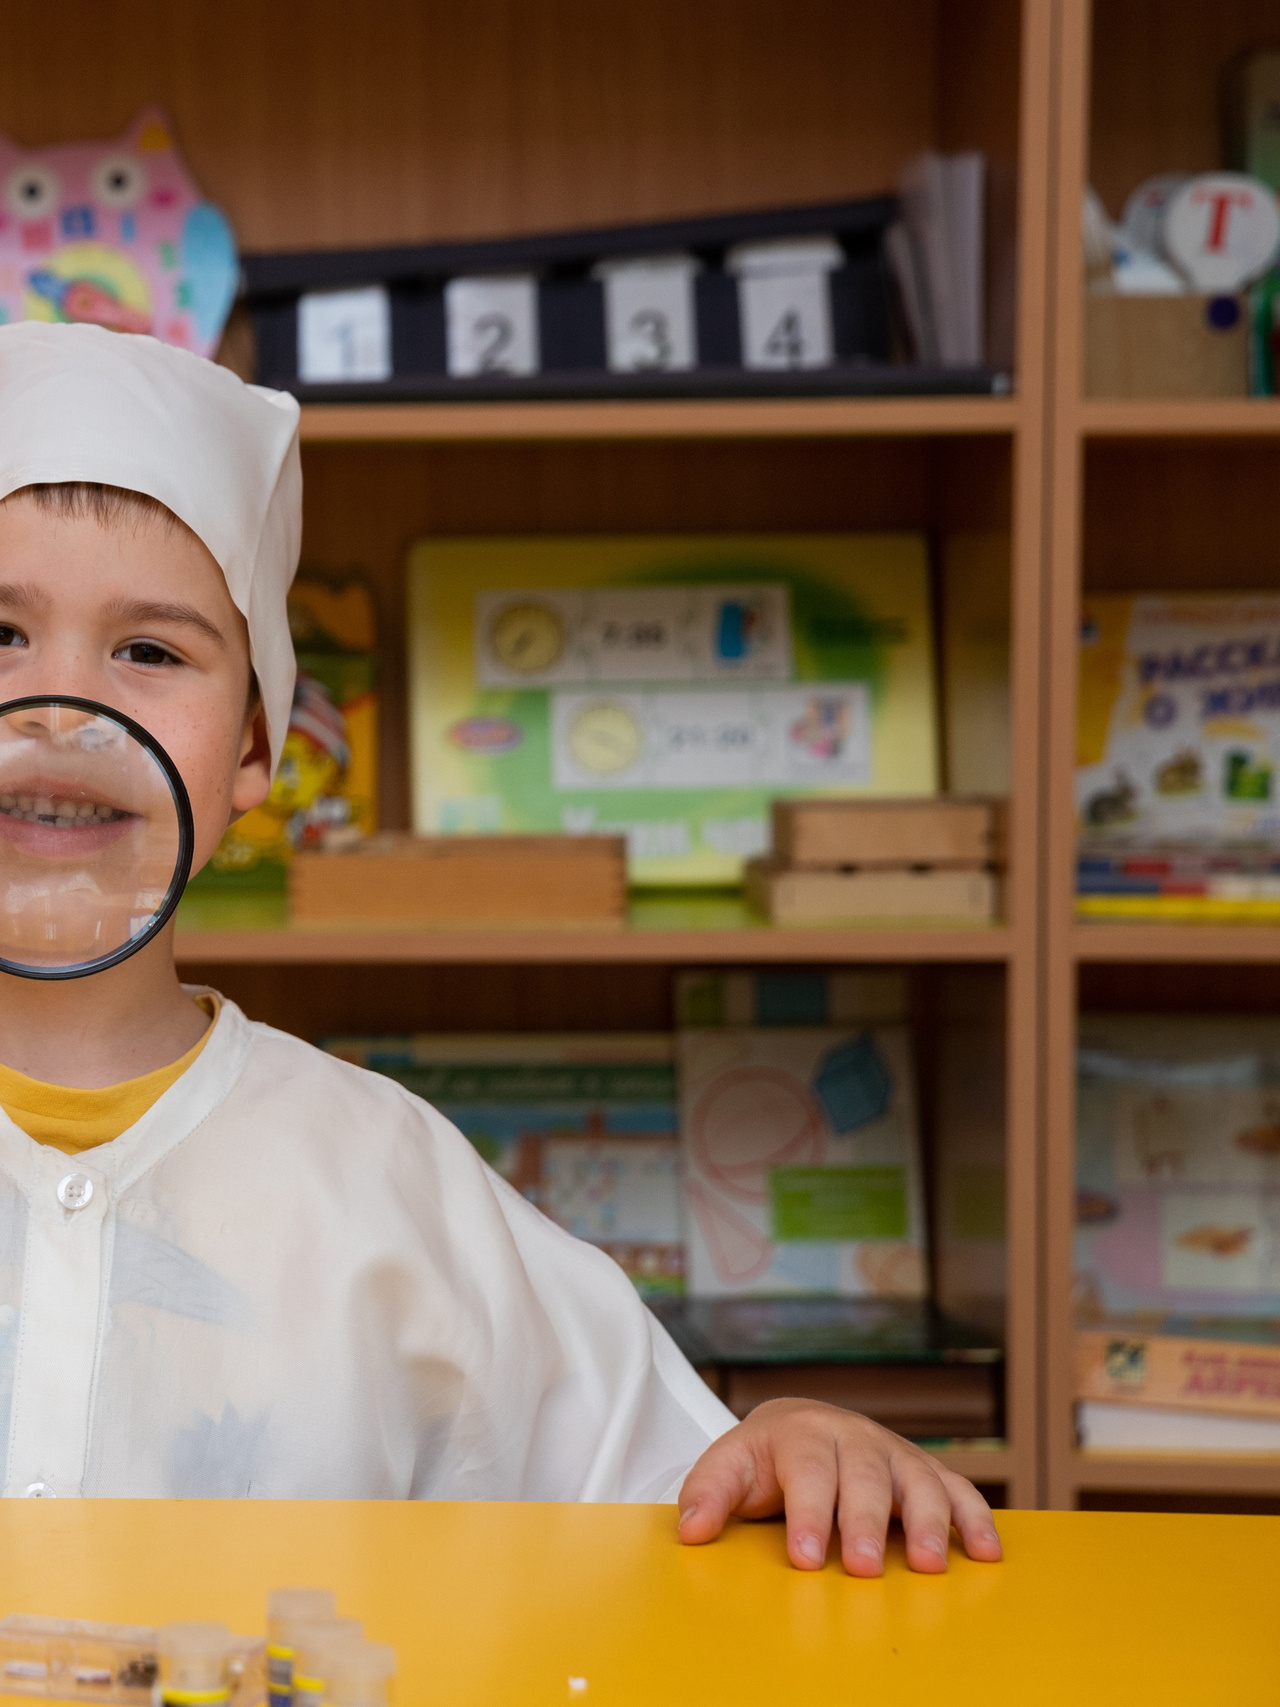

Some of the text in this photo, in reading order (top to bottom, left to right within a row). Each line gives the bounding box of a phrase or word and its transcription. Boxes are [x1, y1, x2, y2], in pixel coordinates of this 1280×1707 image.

[327, 318, 359, 382] 1
[471, 313, 515, 377] 2
[629, 308, 671, 374] 3
[763, 306, 804, 373] 4
